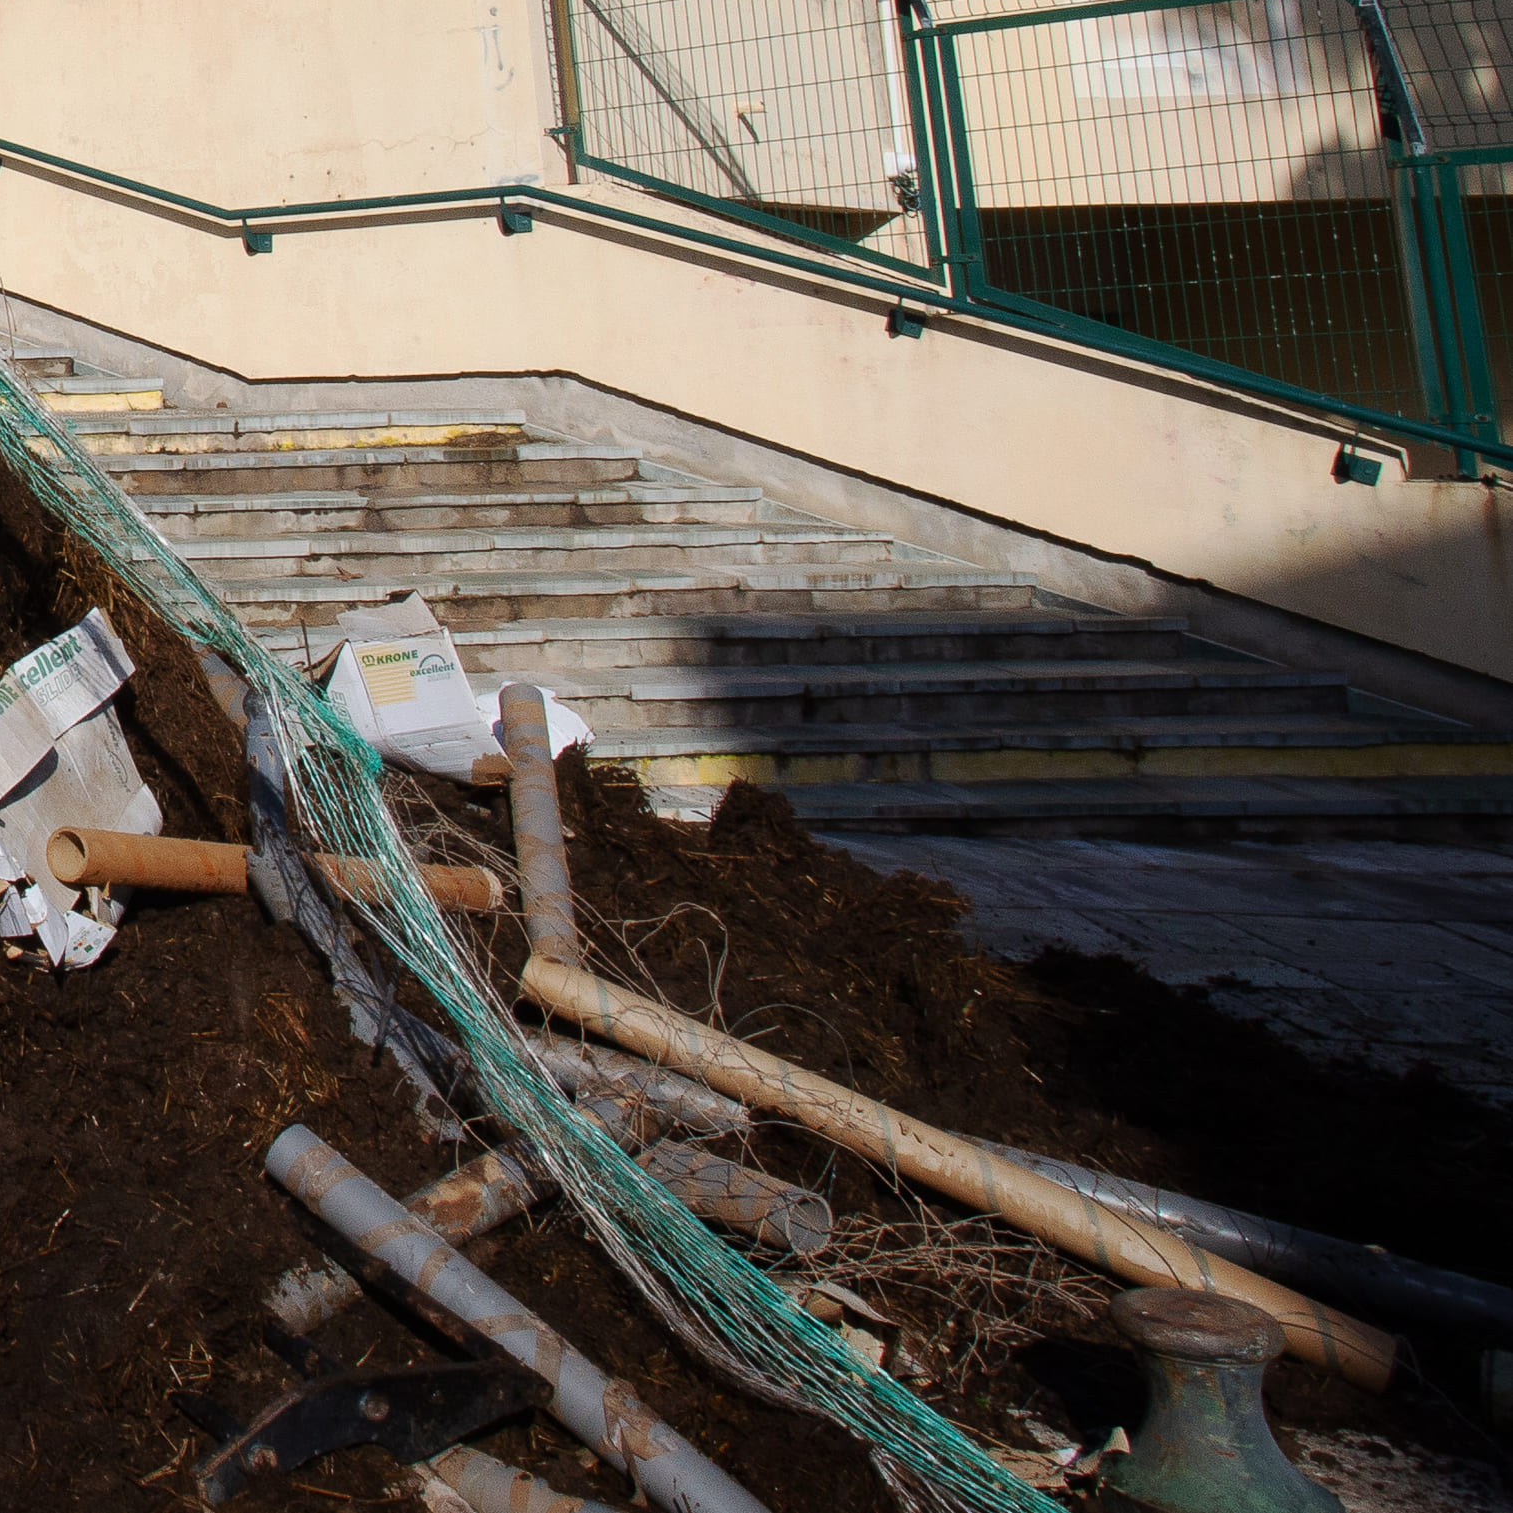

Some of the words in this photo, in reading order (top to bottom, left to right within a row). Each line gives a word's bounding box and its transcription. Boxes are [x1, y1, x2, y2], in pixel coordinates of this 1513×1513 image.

[18, 633, 83, 694] cellent
[376, 649, 419, 666] KRONE
[409, 662, 455, 678] excellent
